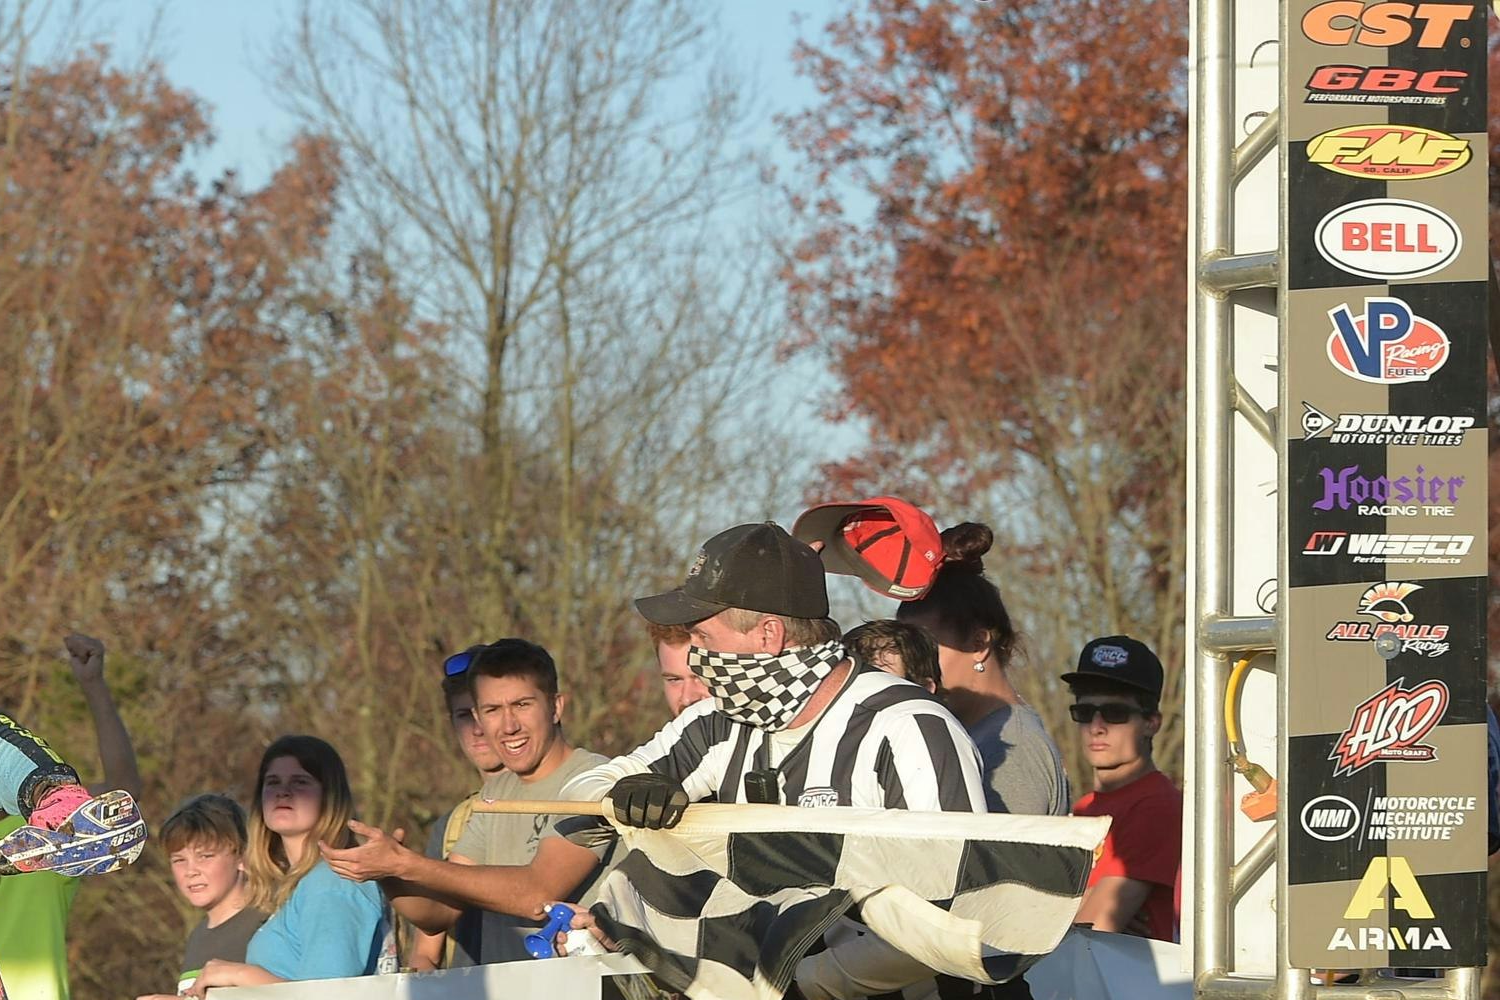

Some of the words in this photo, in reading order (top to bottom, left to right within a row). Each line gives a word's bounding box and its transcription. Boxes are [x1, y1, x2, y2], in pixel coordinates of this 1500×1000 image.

[1301, 0, 1475, 49] CST
[1307, 65, 1469, 94] GBC
[1308, 93, 1367, 104] PERFORMANCE
[1367, 94, 1423, 105] MOTORSPORTS
[1423, 96, 1447, 106] TIRES
[1308, 132, 1469, 167] FMF
[1383, 167, 1415, 175] CALIF.
[1342, 222, 1438, 253] BELL
[1331, 299, 1412, 379] VP
[1386, 341, 1452, 366] Racing
[1387, 367, 1429, 377] FUELS
[1335, 414, 1476, 435] DUNLOP
[1330, 433, 1417, 445] MOTORCYCLE
[1423, 434, 1463, 446] TIRES
[1311, 464, 1466, 512] Hoosier
[1357, 505, 1418, 516] RACING
[1422, 506, 1455, 517] TIRE
[1328, 622, 1371, 640] ALL
[1401, 639, 1450, 657] Racing
[1309, 809, 1352, 828] MMI
[1373, 796, 1476, 810] MOTORCYCLE
[1370, 811, 1464, 826] MECHANICS
[1368, 826, 1452, 840] INSTITUTE
[1327, 927, 1452, 951] ARMA
